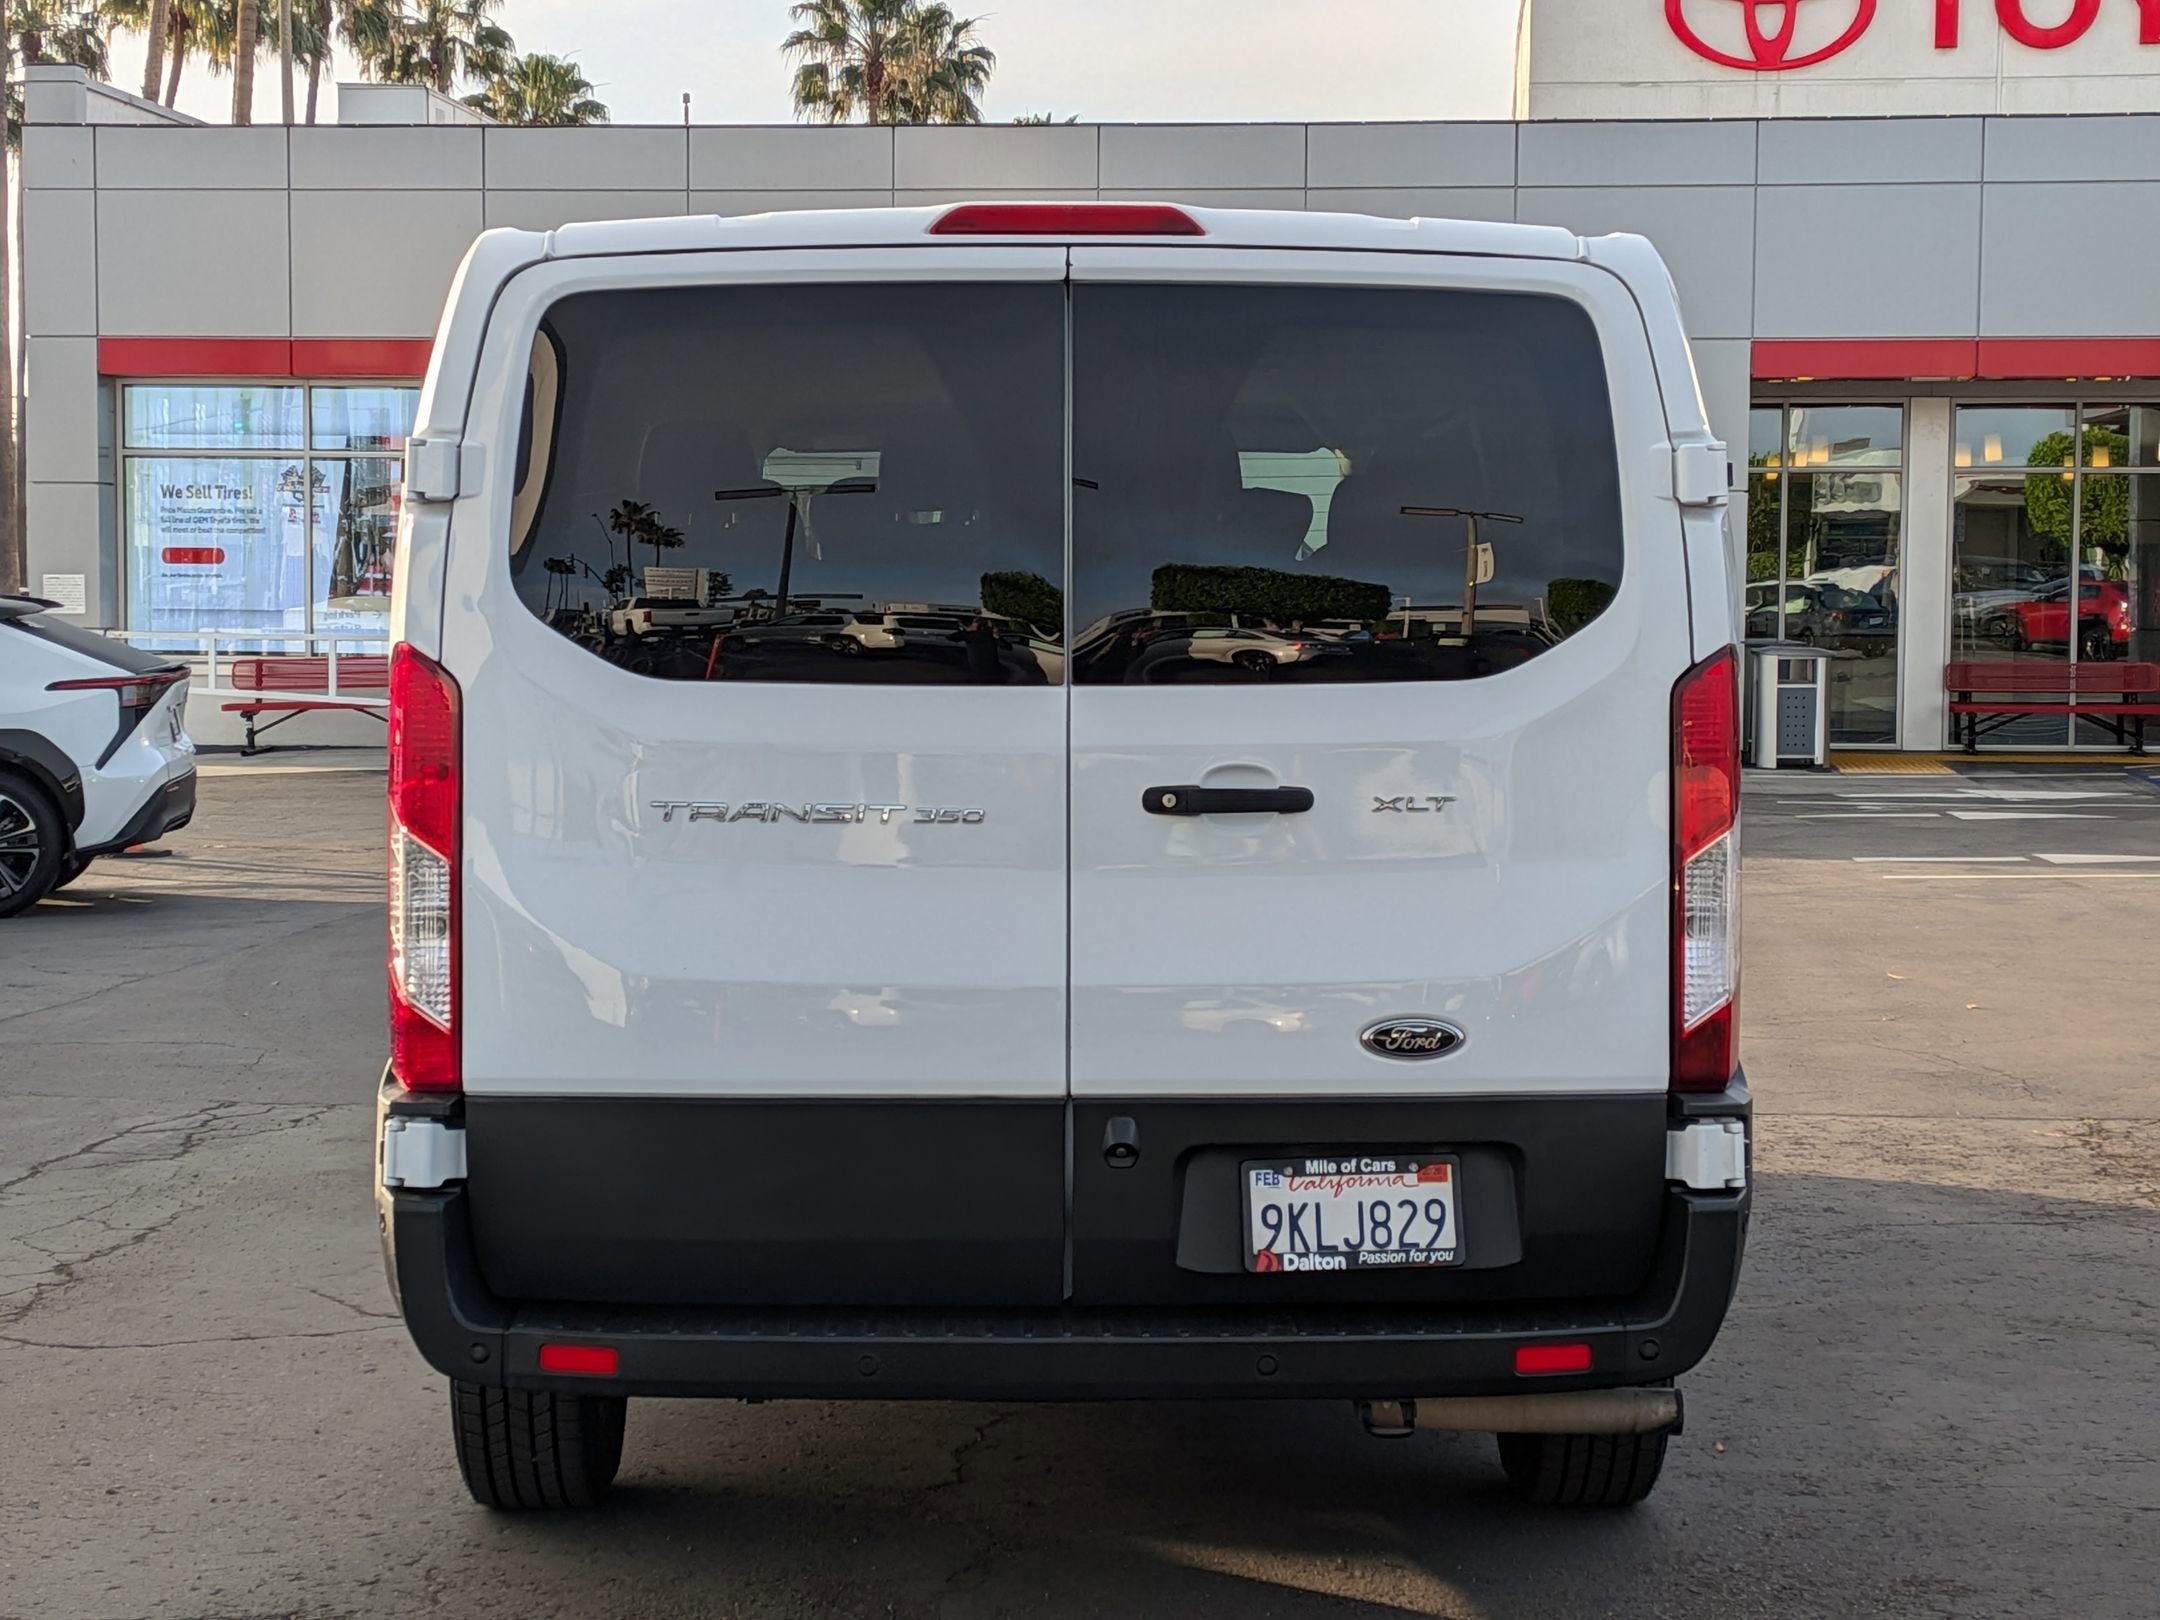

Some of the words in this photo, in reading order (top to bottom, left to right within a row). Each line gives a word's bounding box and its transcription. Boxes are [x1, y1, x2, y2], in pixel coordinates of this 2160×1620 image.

[160, 484, 183, 499] We
[186, 484, 212, 499] Sell
[214, 484, 253, 500] Tires!
[650, 800, 907, 824] TRANSIT
[914, 806, 985, 824] 350
[1372, 796, 1457, 812] XLT
[1375, 1027, 1442, 1050] Ford
[1305, 1159, 1337, 1174] Mile
[1341, 1158, 1357, 1172] of
[1361, 1158, 1396, 1172] Cars
[1255, 1171, 1280, 1187] FEB
[1289, 1173, 1419, 1198] California
[1260, 1198, 1446, 1252] 9KLJ829
[1283, 1252, 1347, 1271] Dalton
[1359, 1251, 1406, 1264] Passion
[1409, 1249, 1428, 1262] for
[1428, 1250, 1454, 1264] you
